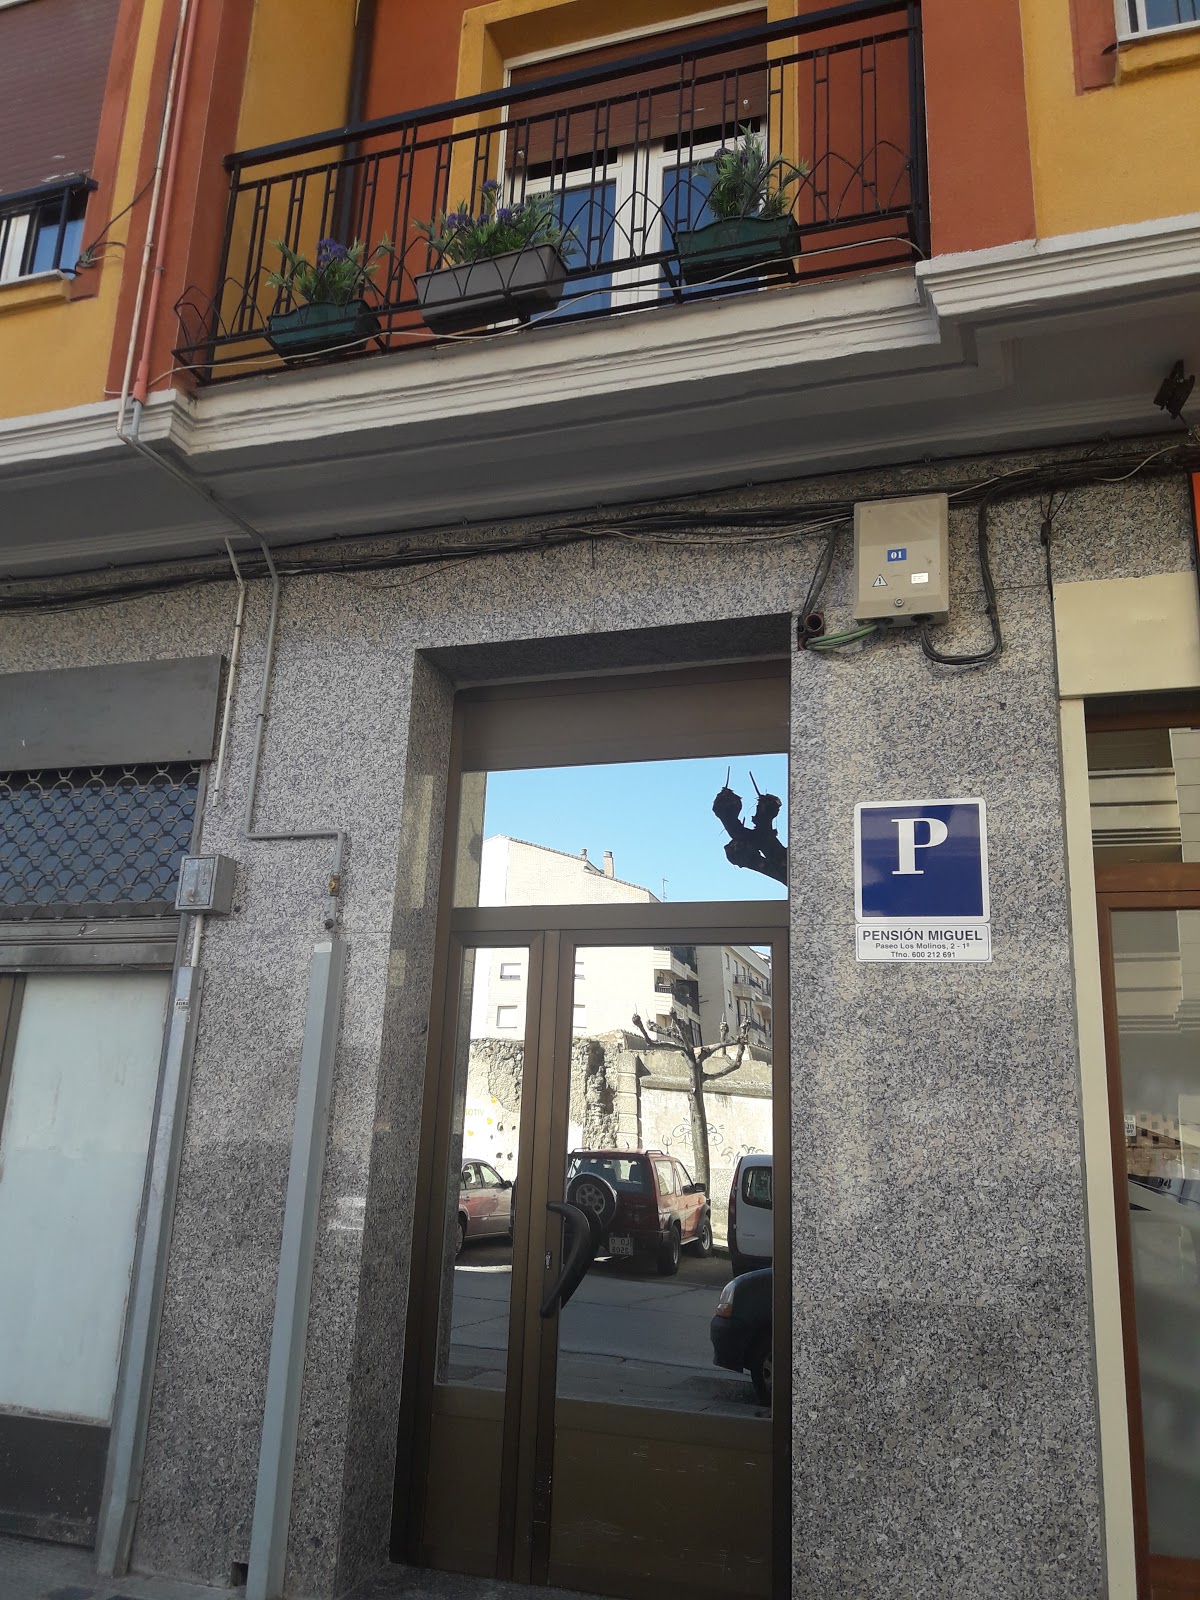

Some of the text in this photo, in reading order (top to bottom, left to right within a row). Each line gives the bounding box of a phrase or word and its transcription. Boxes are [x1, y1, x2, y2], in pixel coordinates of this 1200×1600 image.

[890, 551, 902, 559] 01
[891, 817, 948, 875] P
[862, 928, 983, 941] PENSIÓN MIGUEL
[916, 942, 949, 950] Molinos,
